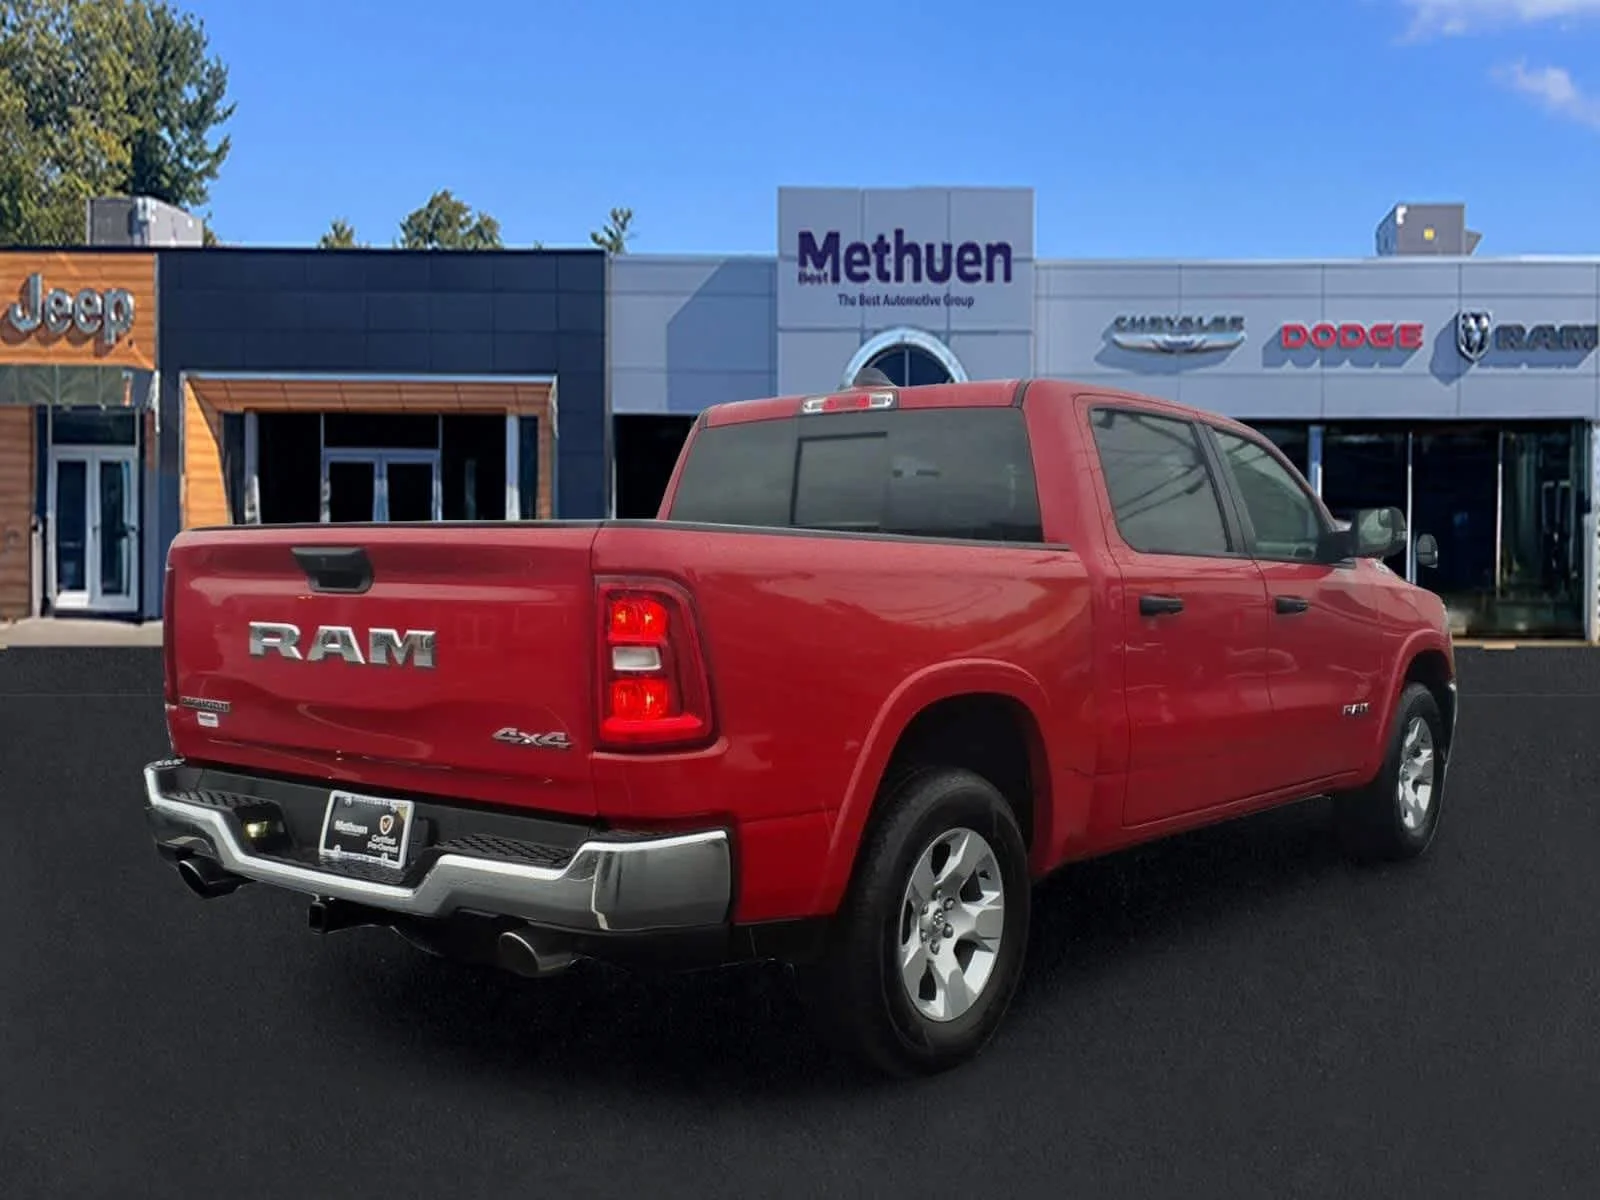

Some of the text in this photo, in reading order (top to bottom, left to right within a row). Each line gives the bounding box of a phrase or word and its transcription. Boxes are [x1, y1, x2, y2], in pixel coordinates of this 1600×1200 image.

[798, 228, 1012, 284] Methuen
[797, 271, 829, 285] Best
[9, 272, 135, 344] Jeep
[838, 293, 975, 309] The Best Automotive Group
[1114, 315, 1245, 333] CHRYSLER
[1281, 323, 1424, 349] DODGE
[1495, 323, 1599, 351] RAM
[248, 620, 436, 668] RAM
[491, 727, 572, 749] 4x4
